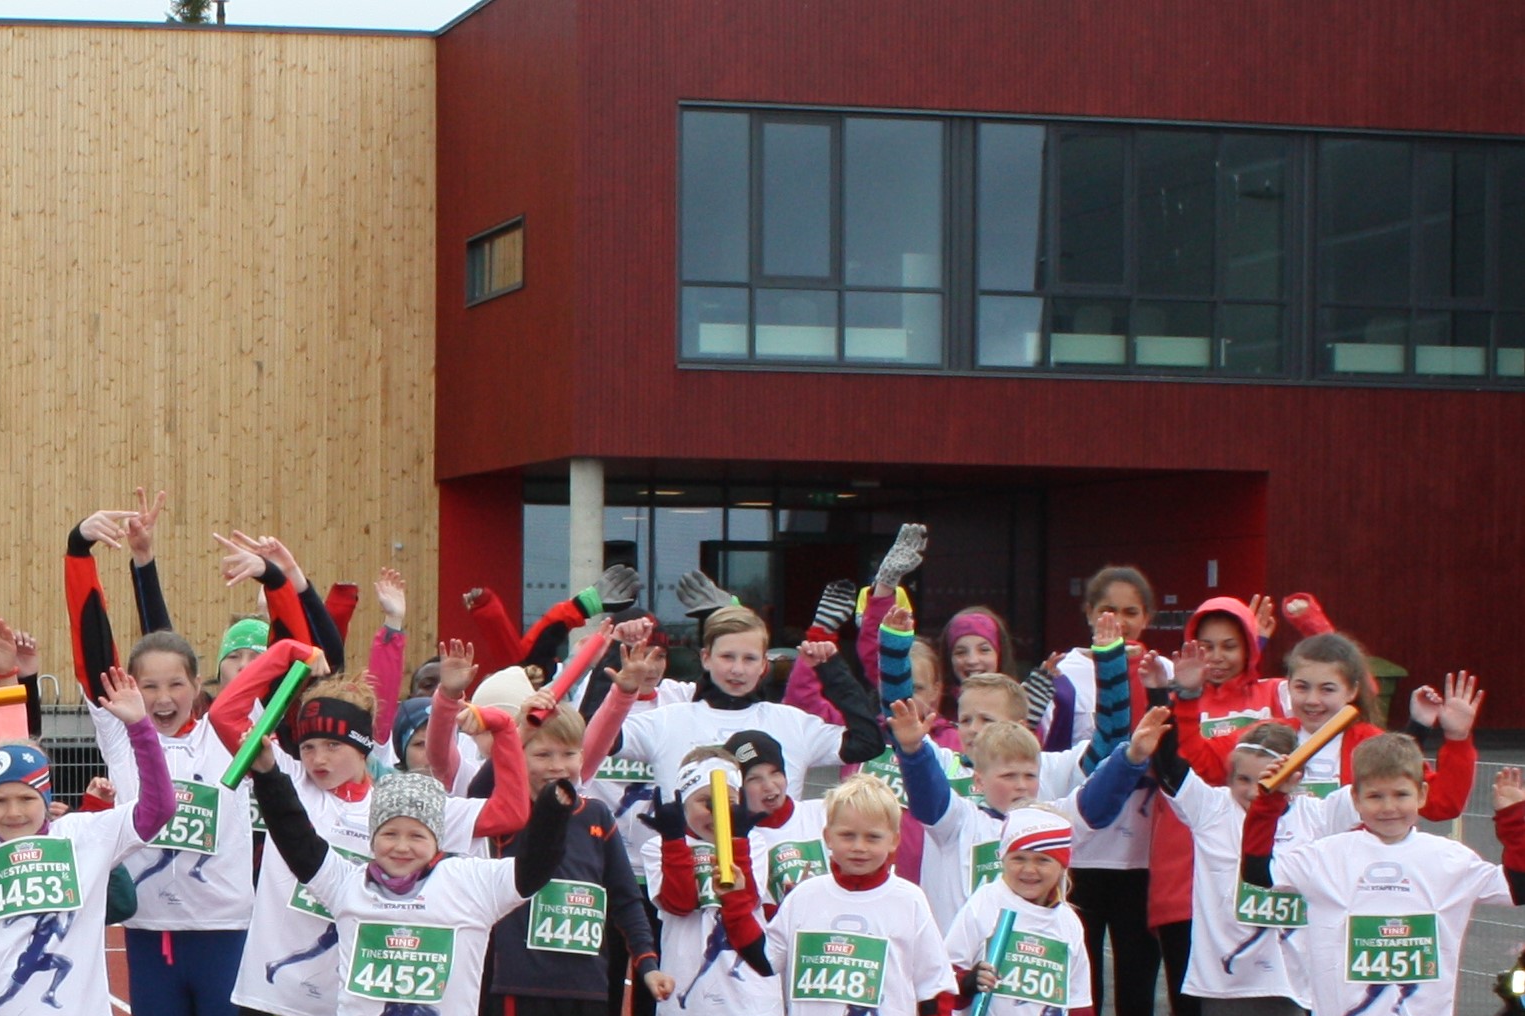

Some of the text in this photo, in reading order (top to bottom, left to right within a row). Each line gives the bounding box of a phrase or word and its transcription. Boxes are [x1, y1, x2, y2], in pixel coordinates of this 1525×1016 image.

[12, 851, 40, 862] TINE
[568, 895, 592, 904] TINE
[1237, 893, 1300, 922] 4451
[534, 916, 604, 949] 4449
[1381, 927, 1406, 935] TINE
[389, 938, 417, 947] TINE
[1353, 936, 1433, 948] TINESTAFETTEN
[360, 948, 448, 963] TINESTAFETTEN
[826, 944, 851, 954] TINE
[1019, 943, 1043, 955] TINE
[799, 955, 880, 971] TINESTAFETTEN
[1351, 950, 1424, 977] 4451
[353, 962, 436, 997] 4452
[796, 968, 866, 999] 4448
